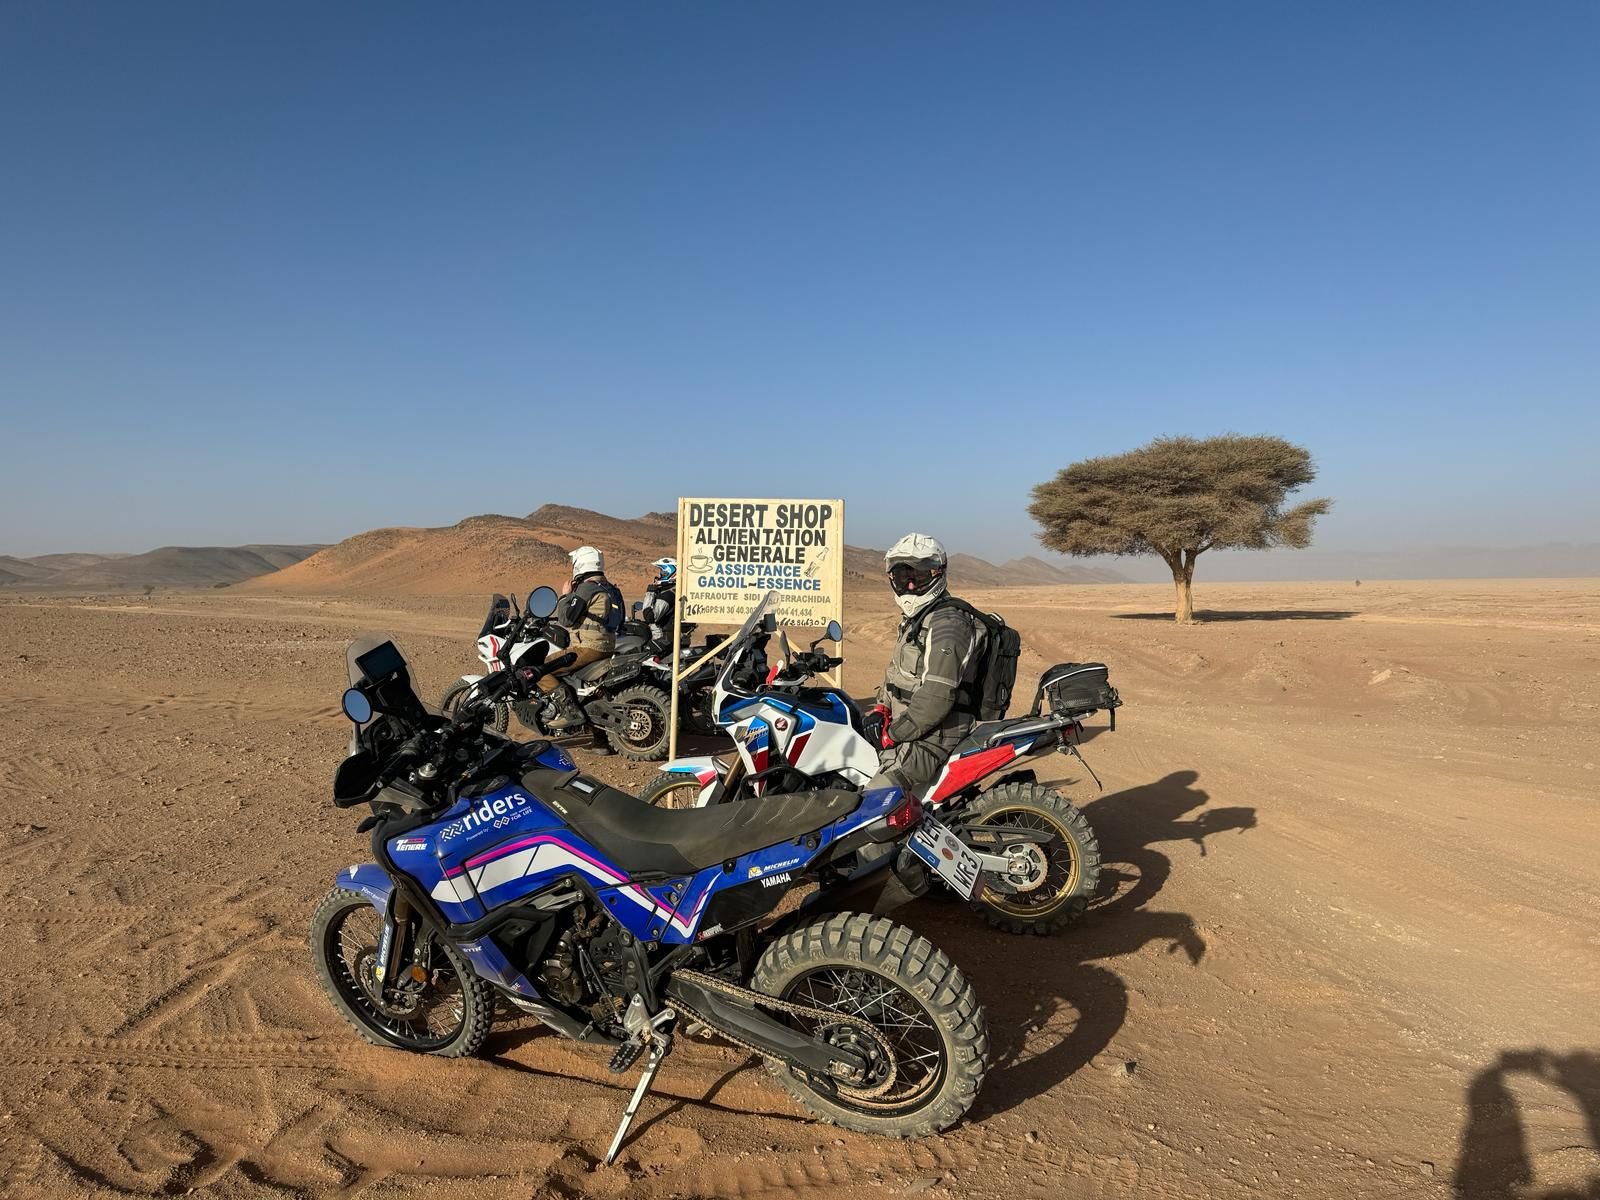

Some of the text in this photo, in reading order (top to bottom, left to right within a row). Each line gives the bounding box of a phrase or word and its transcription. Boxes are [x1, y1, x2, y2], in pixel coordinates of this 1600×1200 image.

[689, 503, 832, 529] DESERT SHOP
[695, 528, 826, 546] ALIMENTATION
[713, 545, 805, 564] GENERALE
[715, 563, 801, 577] ASSISTANCE
[690, 592, 738, 601] TAFRAOUTE
[744, 593, 760, 602] SIDI
[462, 793, 526, 831] riders
[763, 858, 800, 872] MICHELIN
[760, 872, 792, 888] YAMAHA
